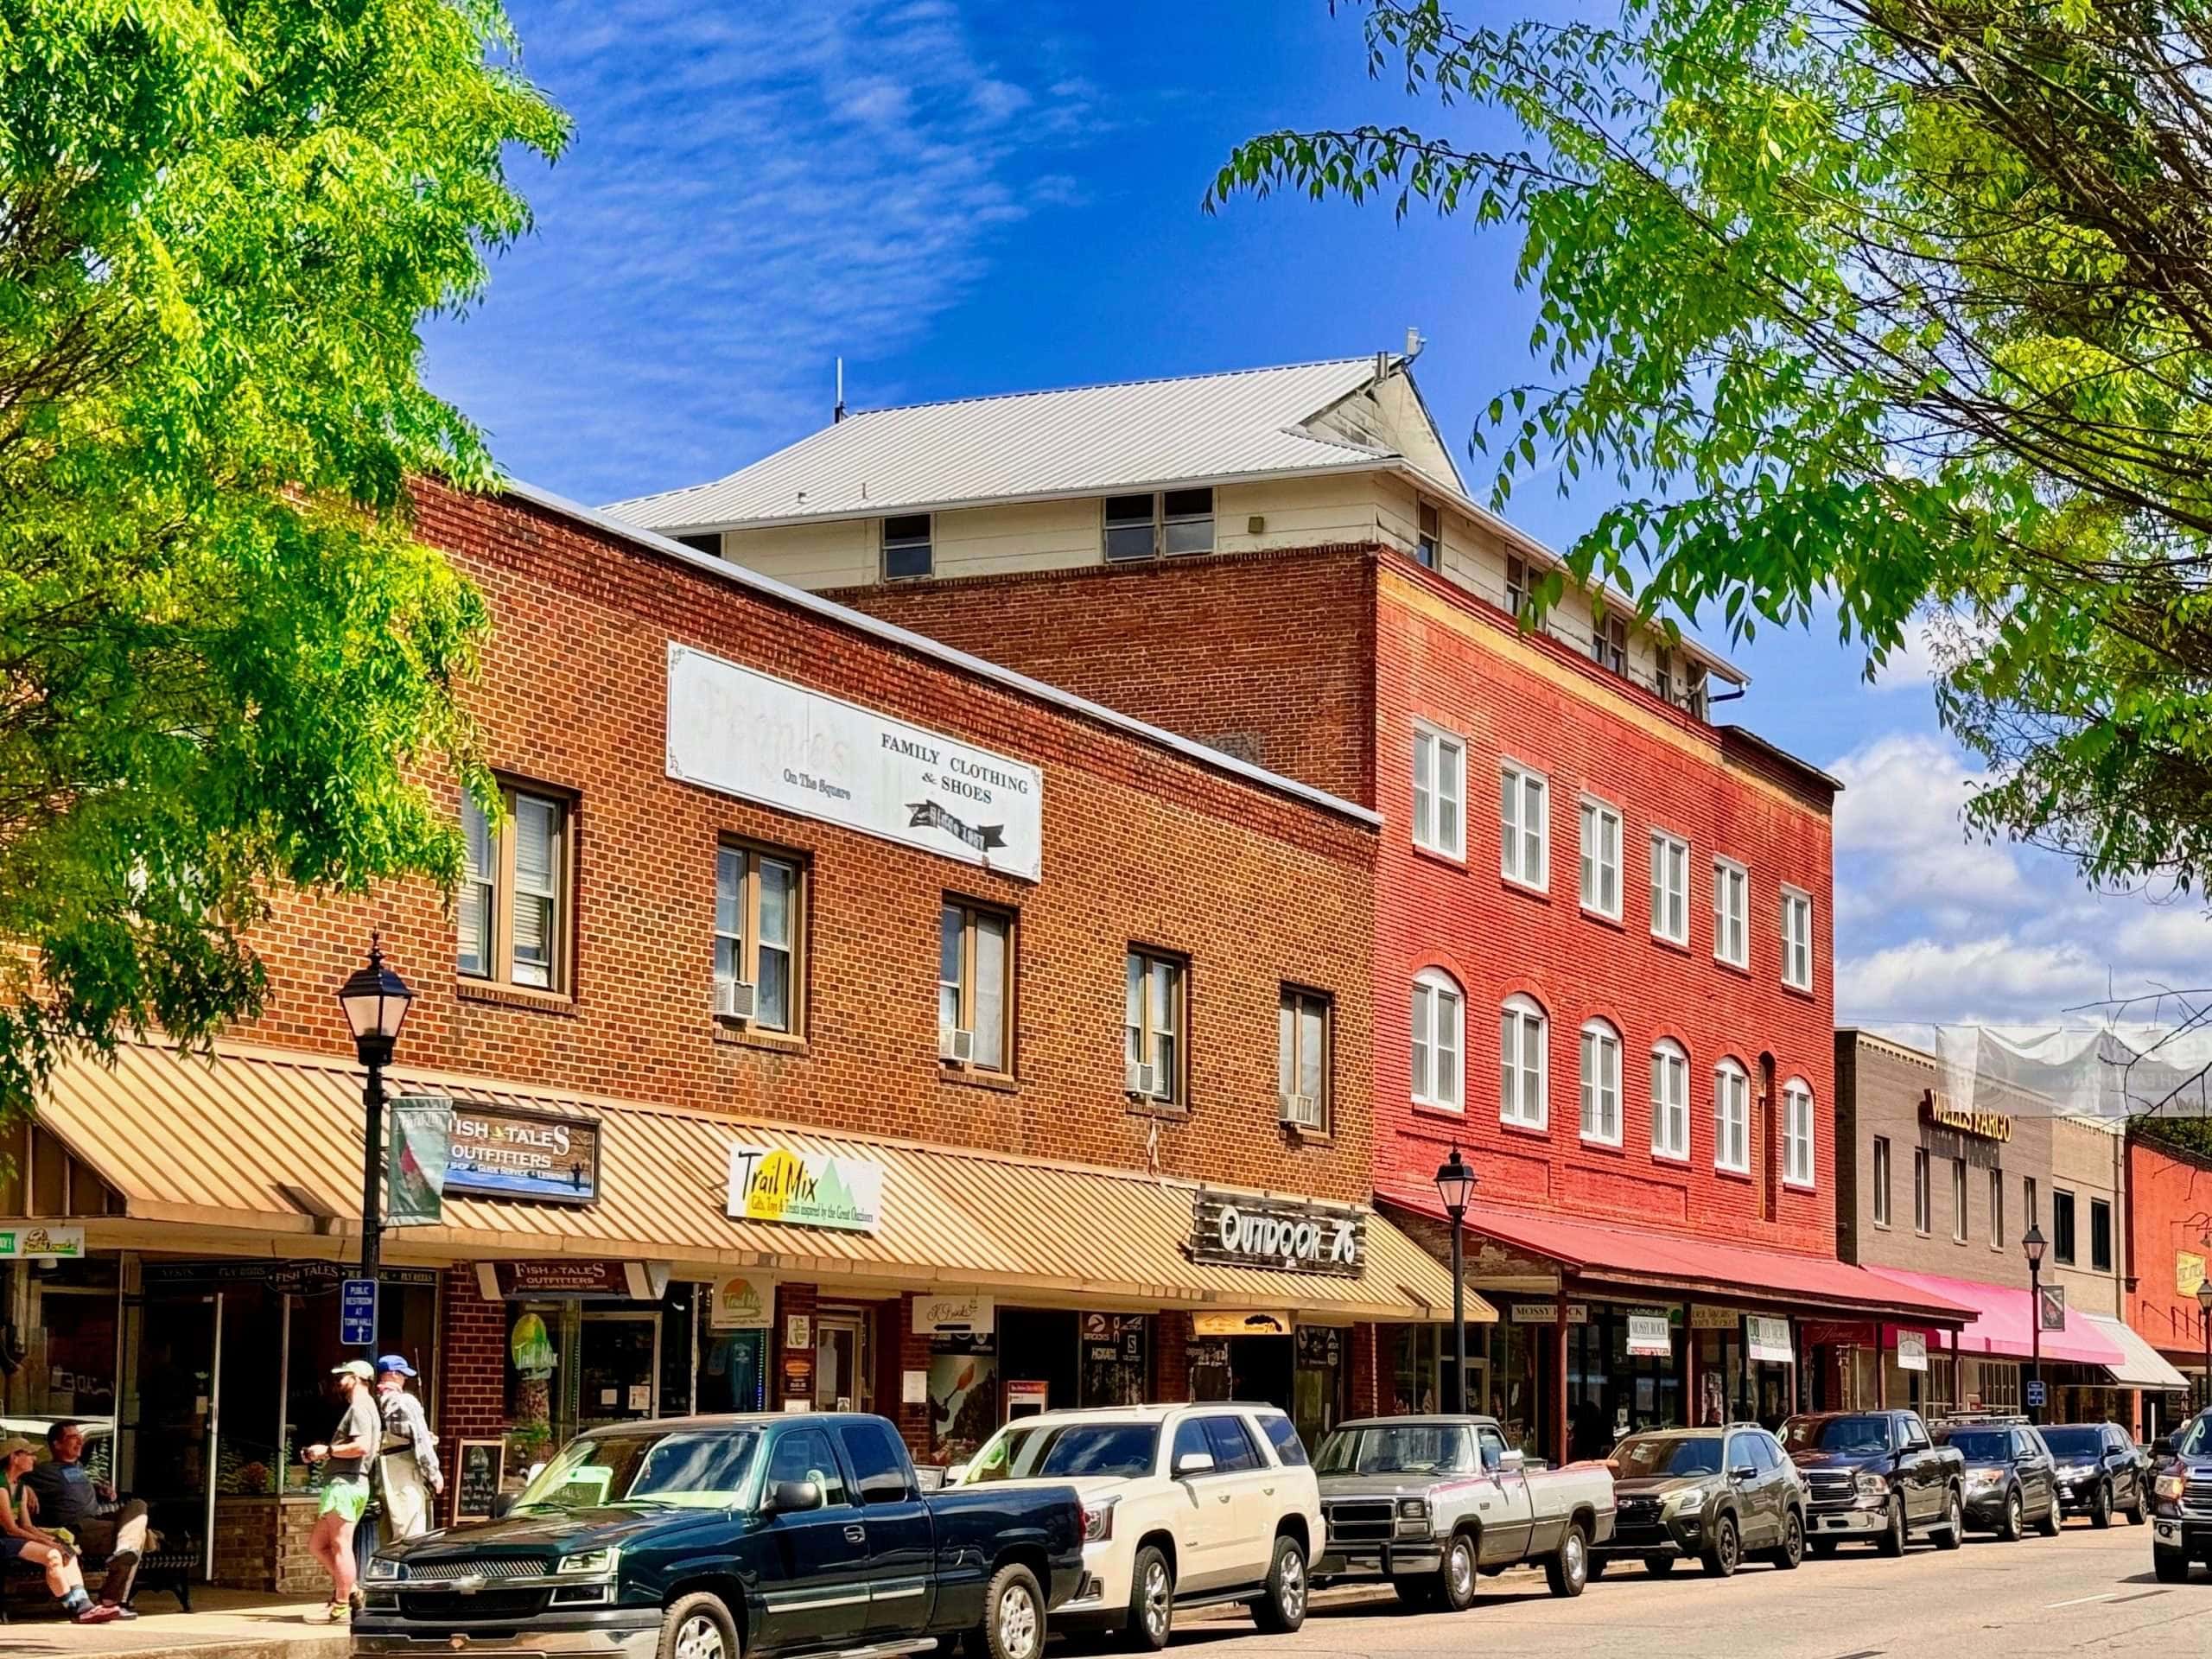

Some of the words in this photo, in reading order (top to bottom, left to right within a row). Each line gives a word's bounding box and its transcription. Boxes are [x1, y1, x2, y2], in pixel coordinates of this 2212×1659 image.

[881, 734, 940, 764] FAMILY
[950, 758, 1028, 794] CLOTHING
[783, 768, 798, 785] On
[799, 774, 817, 790] The
[819, 779, 851, 800] Square
[922, 772, 938, 785] &
[941, 778, 992, 804] SHOES
[1930, 1090, 1972, 1131] WELLS
[1974, 1107, 2012, 1142] FARGO
[451, 1144, 553, 1168] OUTFITTERS
[505, 1124, 570, 1156] TALES
[738, 1150, 781, 1201] Trail
[786, 1160, 818, 1203] Mix
[1219, 1205, 1321, 1259] OUTDOOR
[1330, 1219, 1356, 1265] 76
[276, 1269, 300, 1282] FISH
[302, 1265, 339, 1278] TALES
[514, 1262, 548, 1277] FISH
[557, 1262, 606, 1278] TALES
[1516, 1306, 1549, 1316] MOSSY
